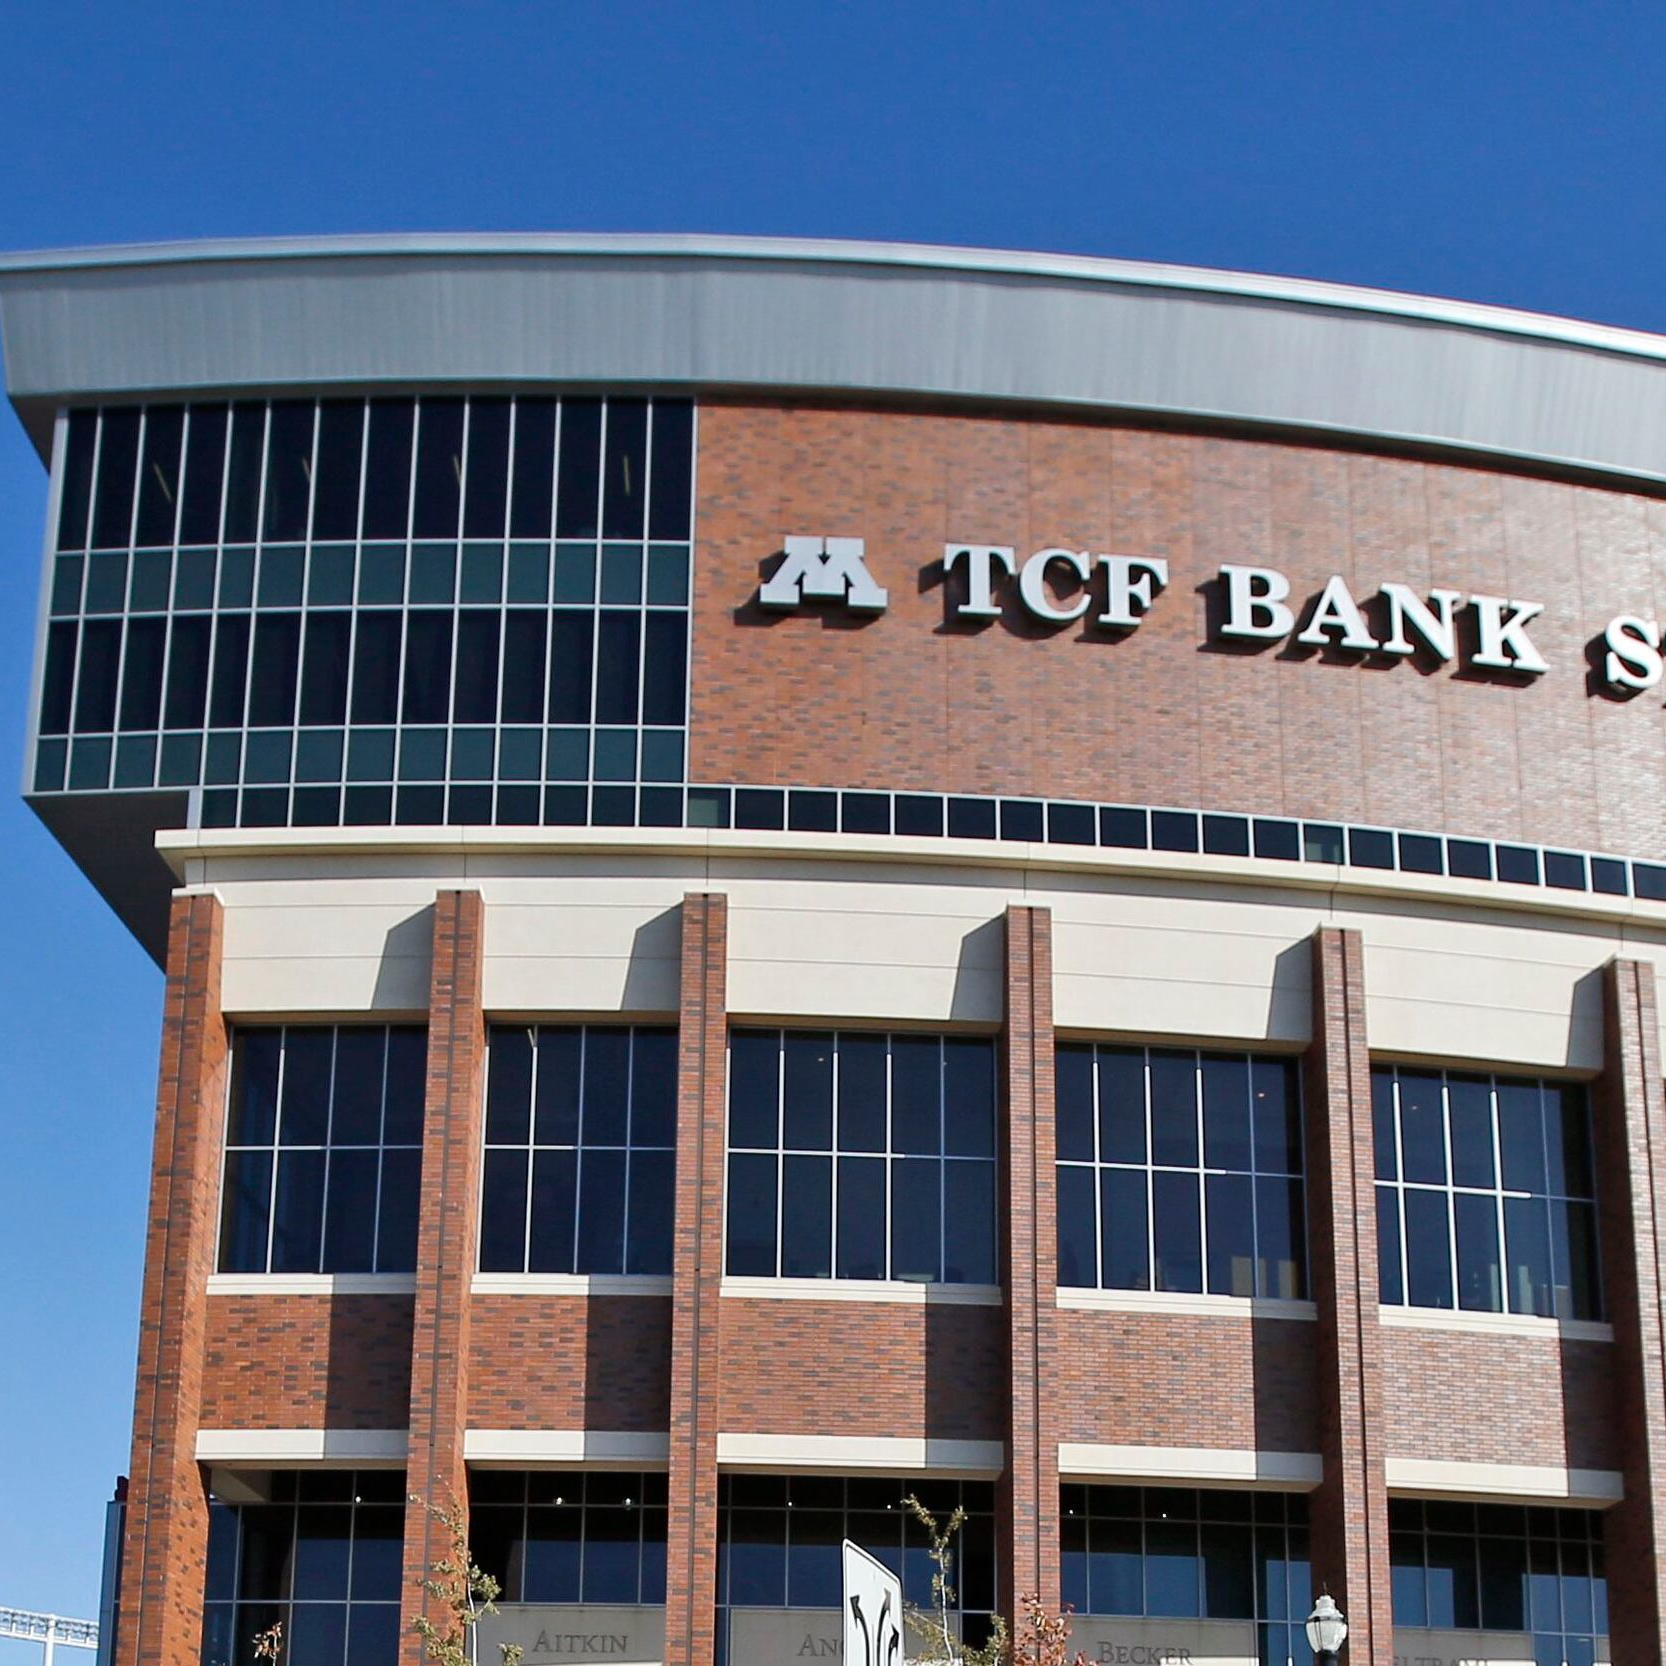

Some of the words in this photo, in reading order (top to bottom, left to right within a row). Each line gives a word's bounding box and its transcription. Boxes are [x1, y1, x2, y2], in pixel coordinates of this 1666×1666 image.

[945, 542, 1169, 628] TCF
[1219, 562, 1547, 676] BANK
[534, 1628, 629, 1654] AITKIN
[1096, 1640, 1194, 1666] BECKER
